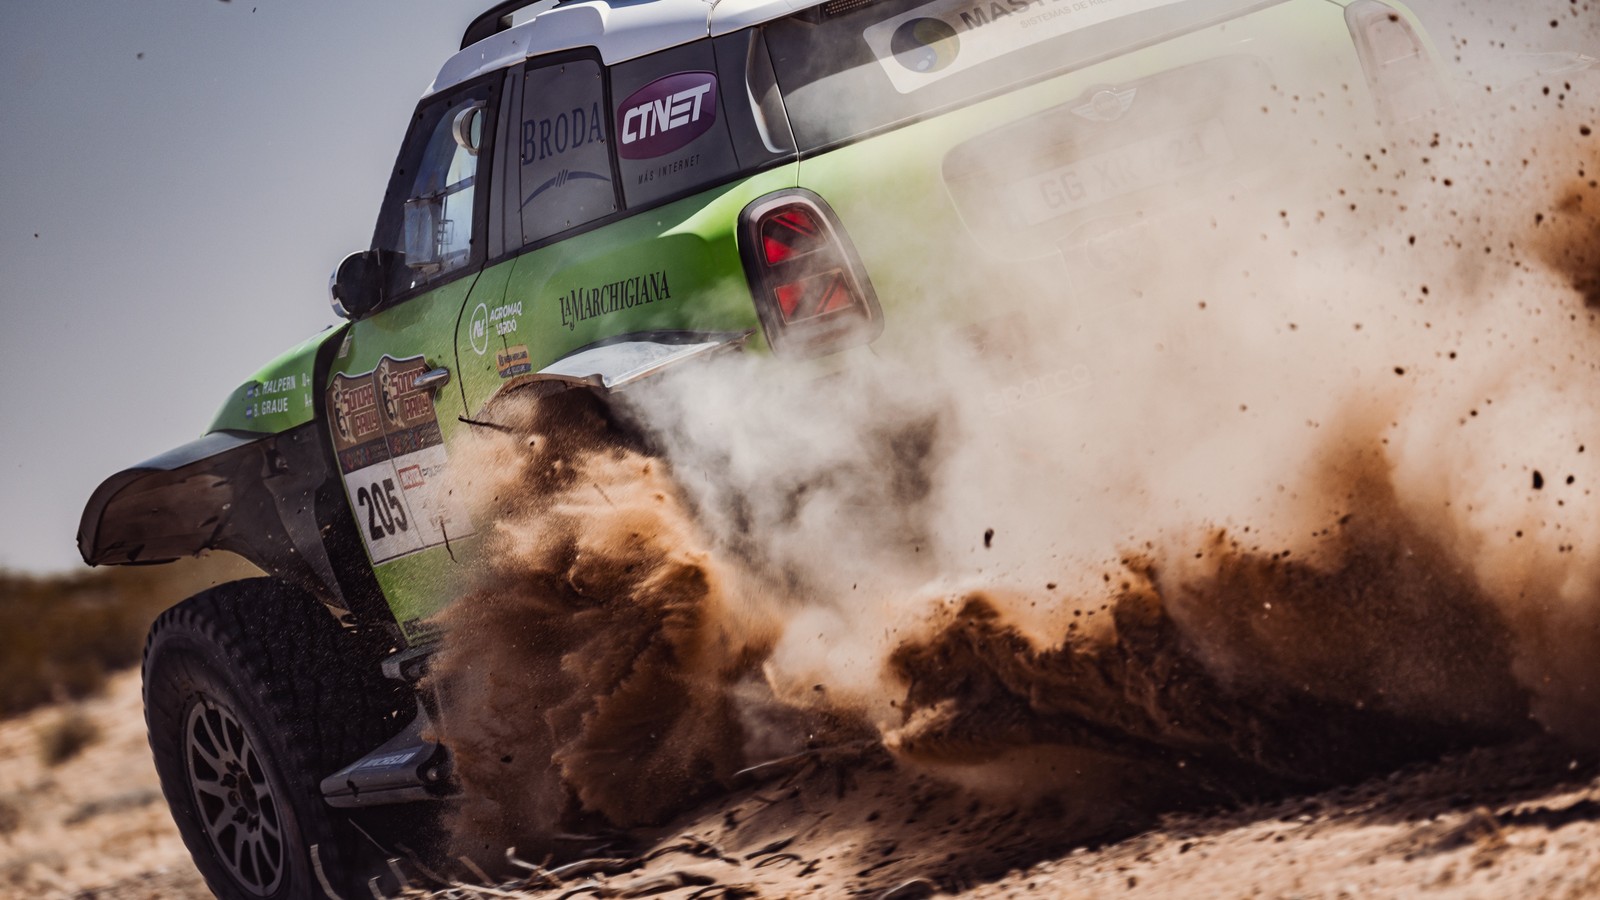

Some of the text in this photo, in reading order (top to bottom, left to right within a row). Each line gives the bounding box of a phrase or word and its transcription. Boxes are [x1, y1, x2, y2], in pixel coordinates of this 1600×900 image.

[1020, 6, 1071, 29] SISTEMAS
[1072, 0, 1088, 11] DE
[622, 83, 711, 144] CTNET
[522, 102, 603, 166] BRODA
[638, 154, 700, 185] MÁS INTERNET
[1040, 171, 1087, 209] GG
[490, 301, 522, 322] AGROMAQ
[262, 397, 288, 416] GRAUE
[356, 477, 408, 541] 205
